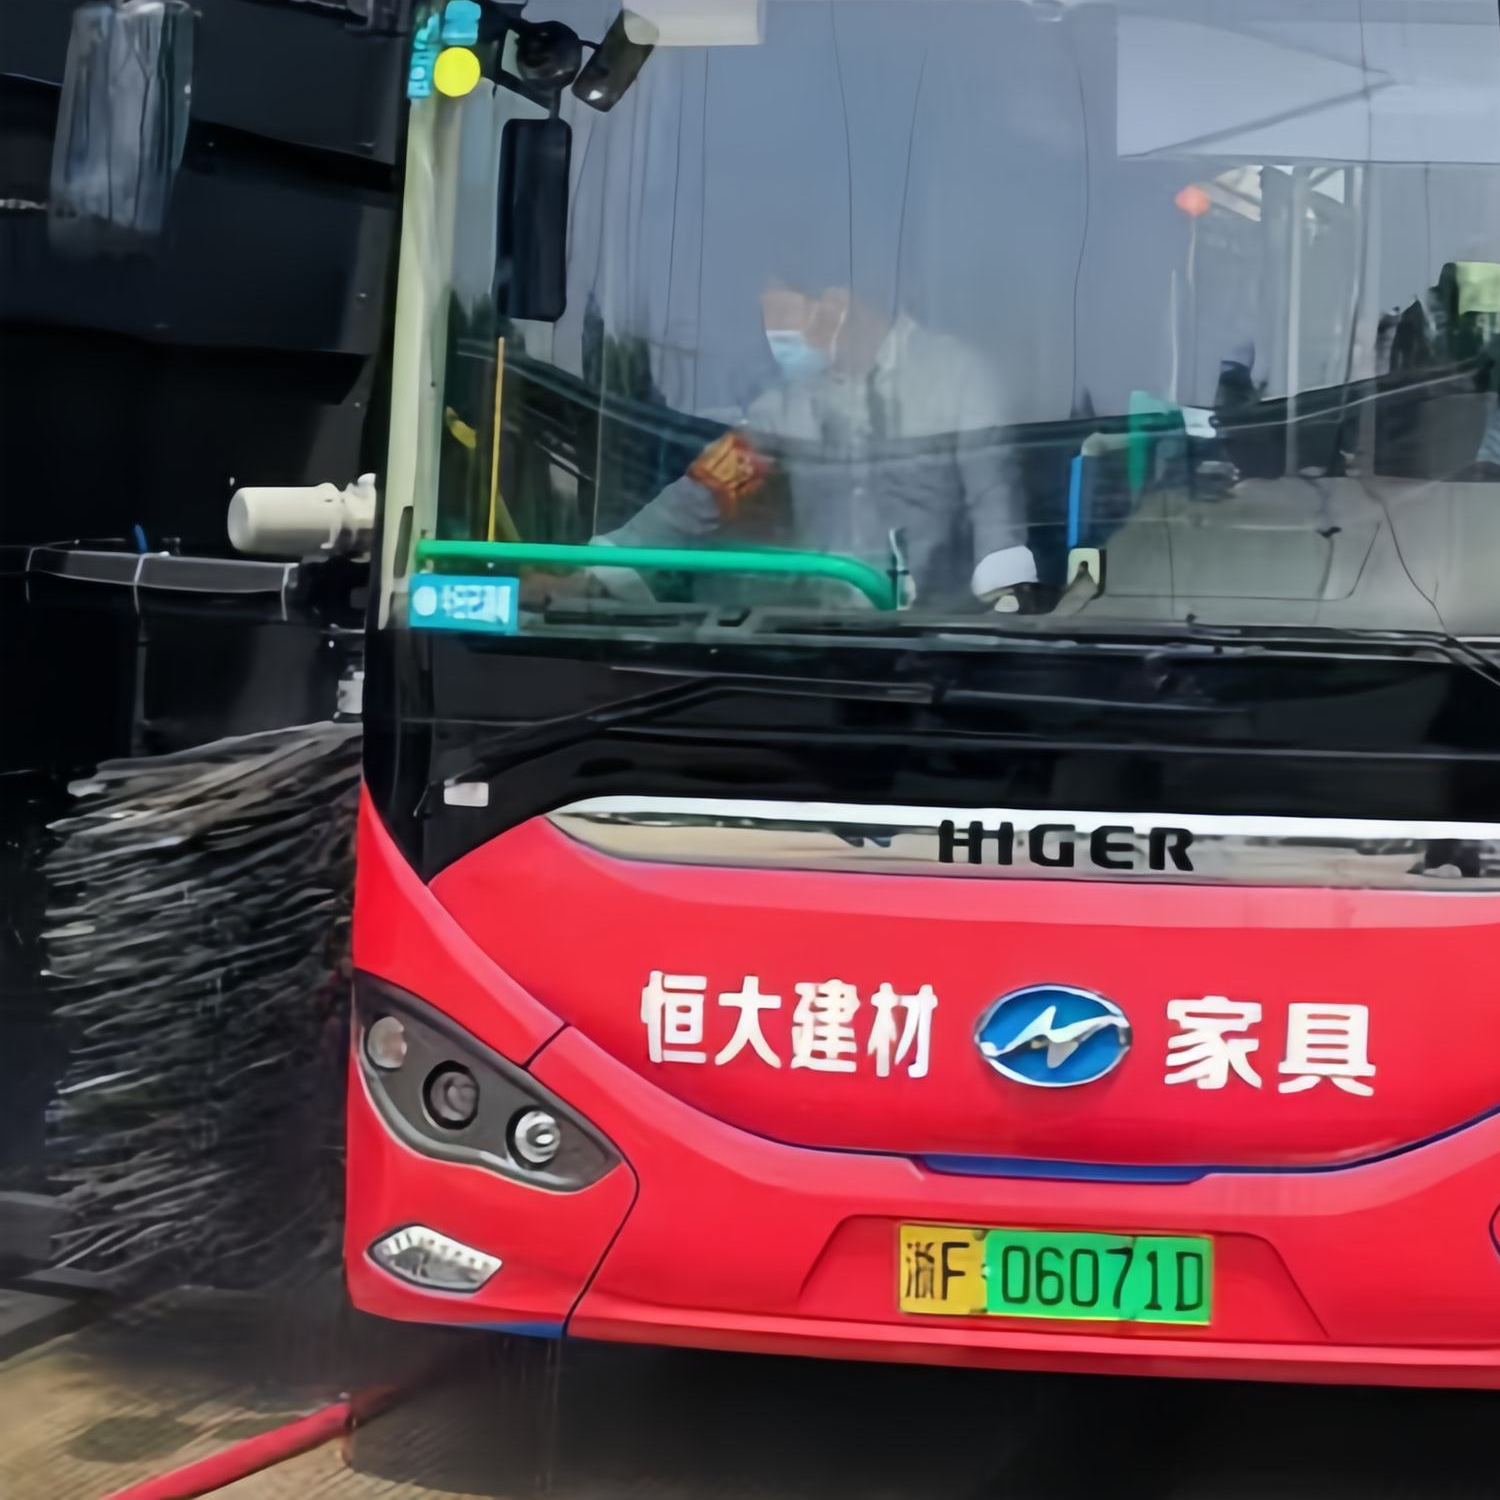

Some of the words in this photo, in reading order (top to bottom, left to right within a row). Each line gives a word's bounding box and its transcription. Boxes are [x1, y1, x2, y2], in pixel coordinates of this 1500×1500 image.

[938, 819, 1194, 871] HIGER
[640, 970, 938, 1078] 恒大建材
[1164, 995, 1377, 1097] 家具
